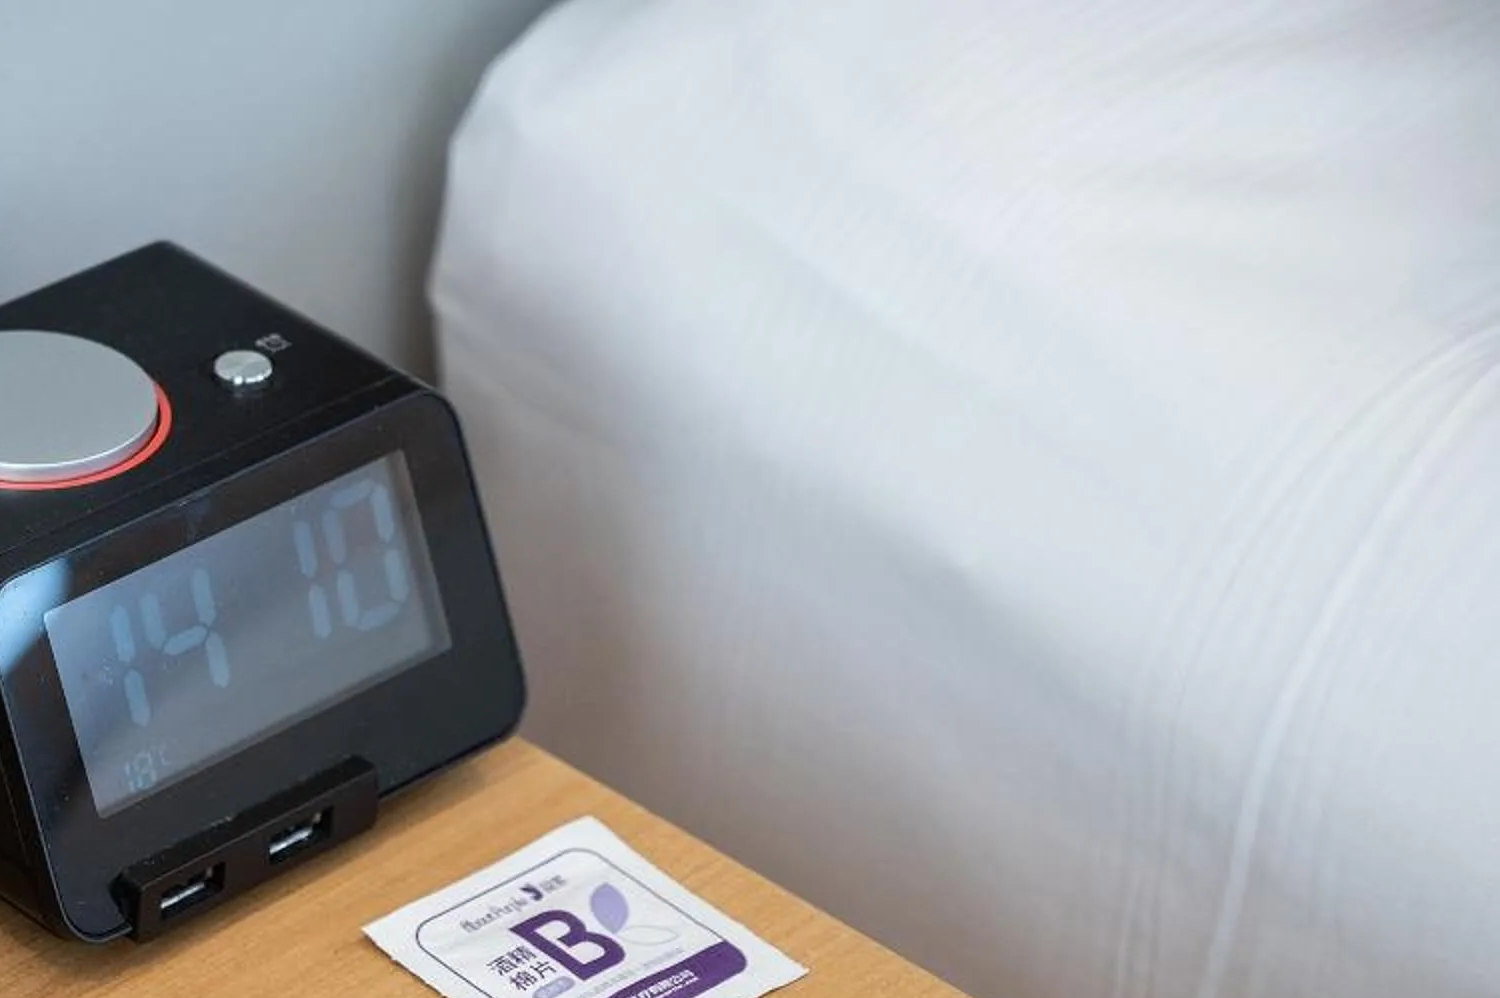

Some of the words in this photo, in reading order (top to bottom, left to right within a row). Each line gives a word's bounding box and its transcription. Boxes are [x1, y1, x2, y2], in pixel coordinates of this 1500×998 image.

[109, 568, 230, 727] 14
[293, 479, 409, 639] 10
[486, 945, 538, 976] 酒精
[509, 909, 626, 981] B
[510, 961, 557, 991] 棉片
